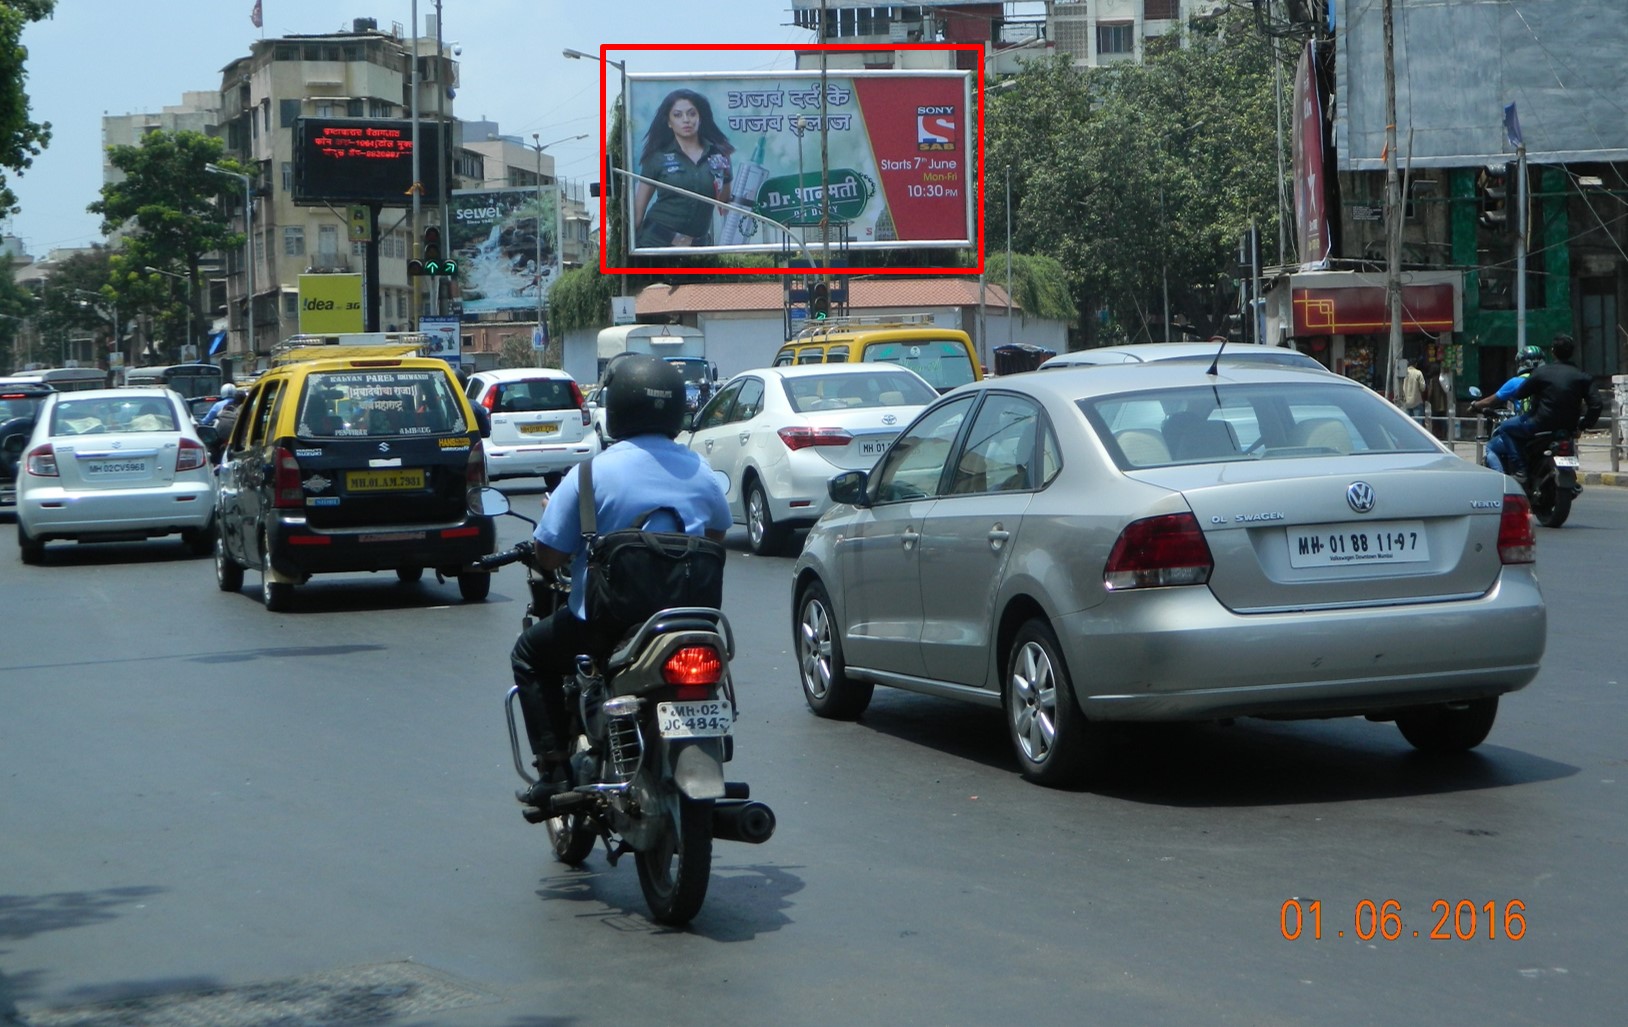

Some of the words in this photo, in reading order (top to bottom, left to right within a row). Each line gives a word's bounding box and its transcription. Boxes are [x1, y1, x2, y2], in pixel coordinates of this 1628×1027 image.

[728, 90, 784, 109] अजब
[825, 84, 851, 106] के
[917, 106, 954, 114] SONY
[728, 115, 784, 132] गजब
[881, 159, 912, 170] Starts
[928, 158, 957, 170] June
[908, 185, 943, 197] 10:30
[945, 188, 958, 196] PM
[330, 375, 362, 383] KALYAN
[366, 374, 394, 382] PAREL
[863, 444, 874, 453] MH
[1470, 500, 1501, 508] VENTO
[1329, 535, 1346, 553] 01
